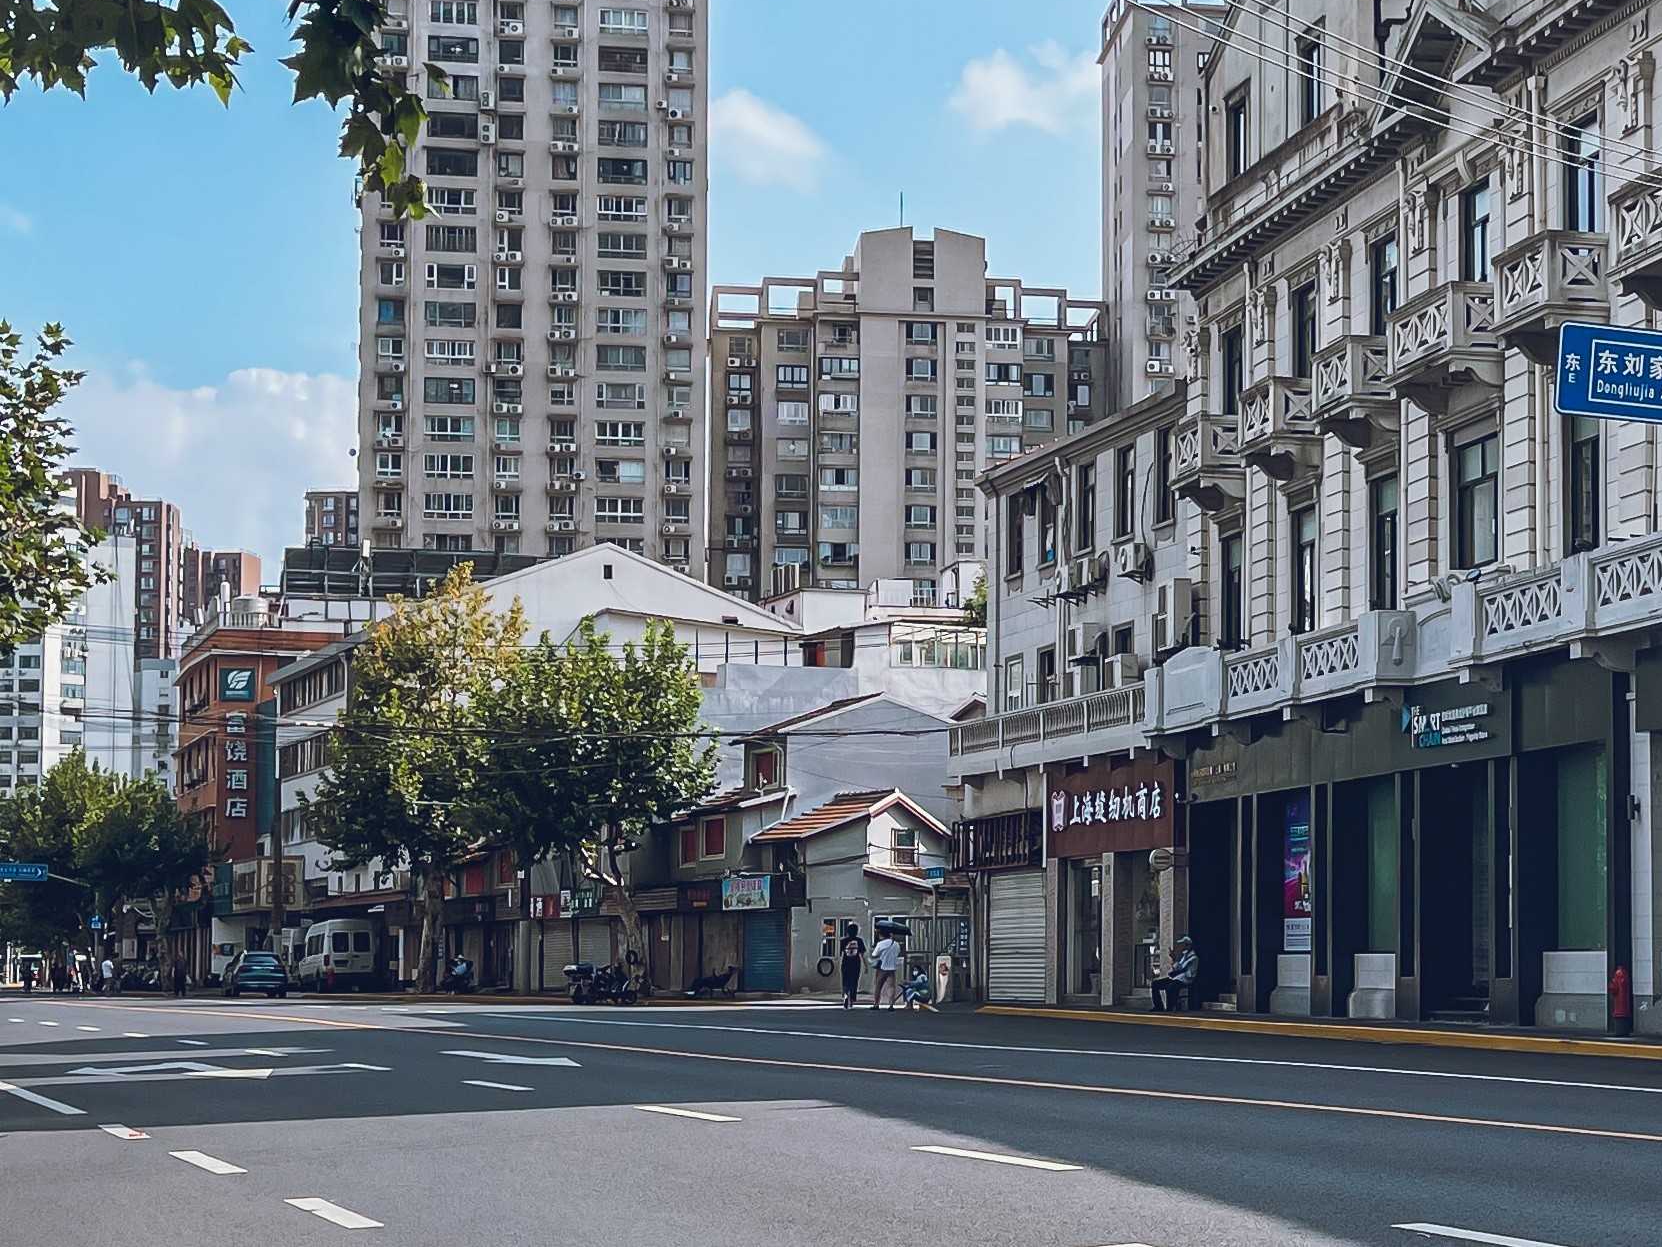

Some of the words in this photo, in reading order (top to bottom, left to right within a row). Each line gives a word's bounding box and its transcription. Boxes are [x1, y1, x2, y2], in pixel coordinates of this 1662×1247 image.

[1565, 353, 1581, 372] 东
[1568, 373, 1576, 384] E
[1597, 379, 1655, 402] Dongliujia
[1413, 713, 1441, 735] SMRT
